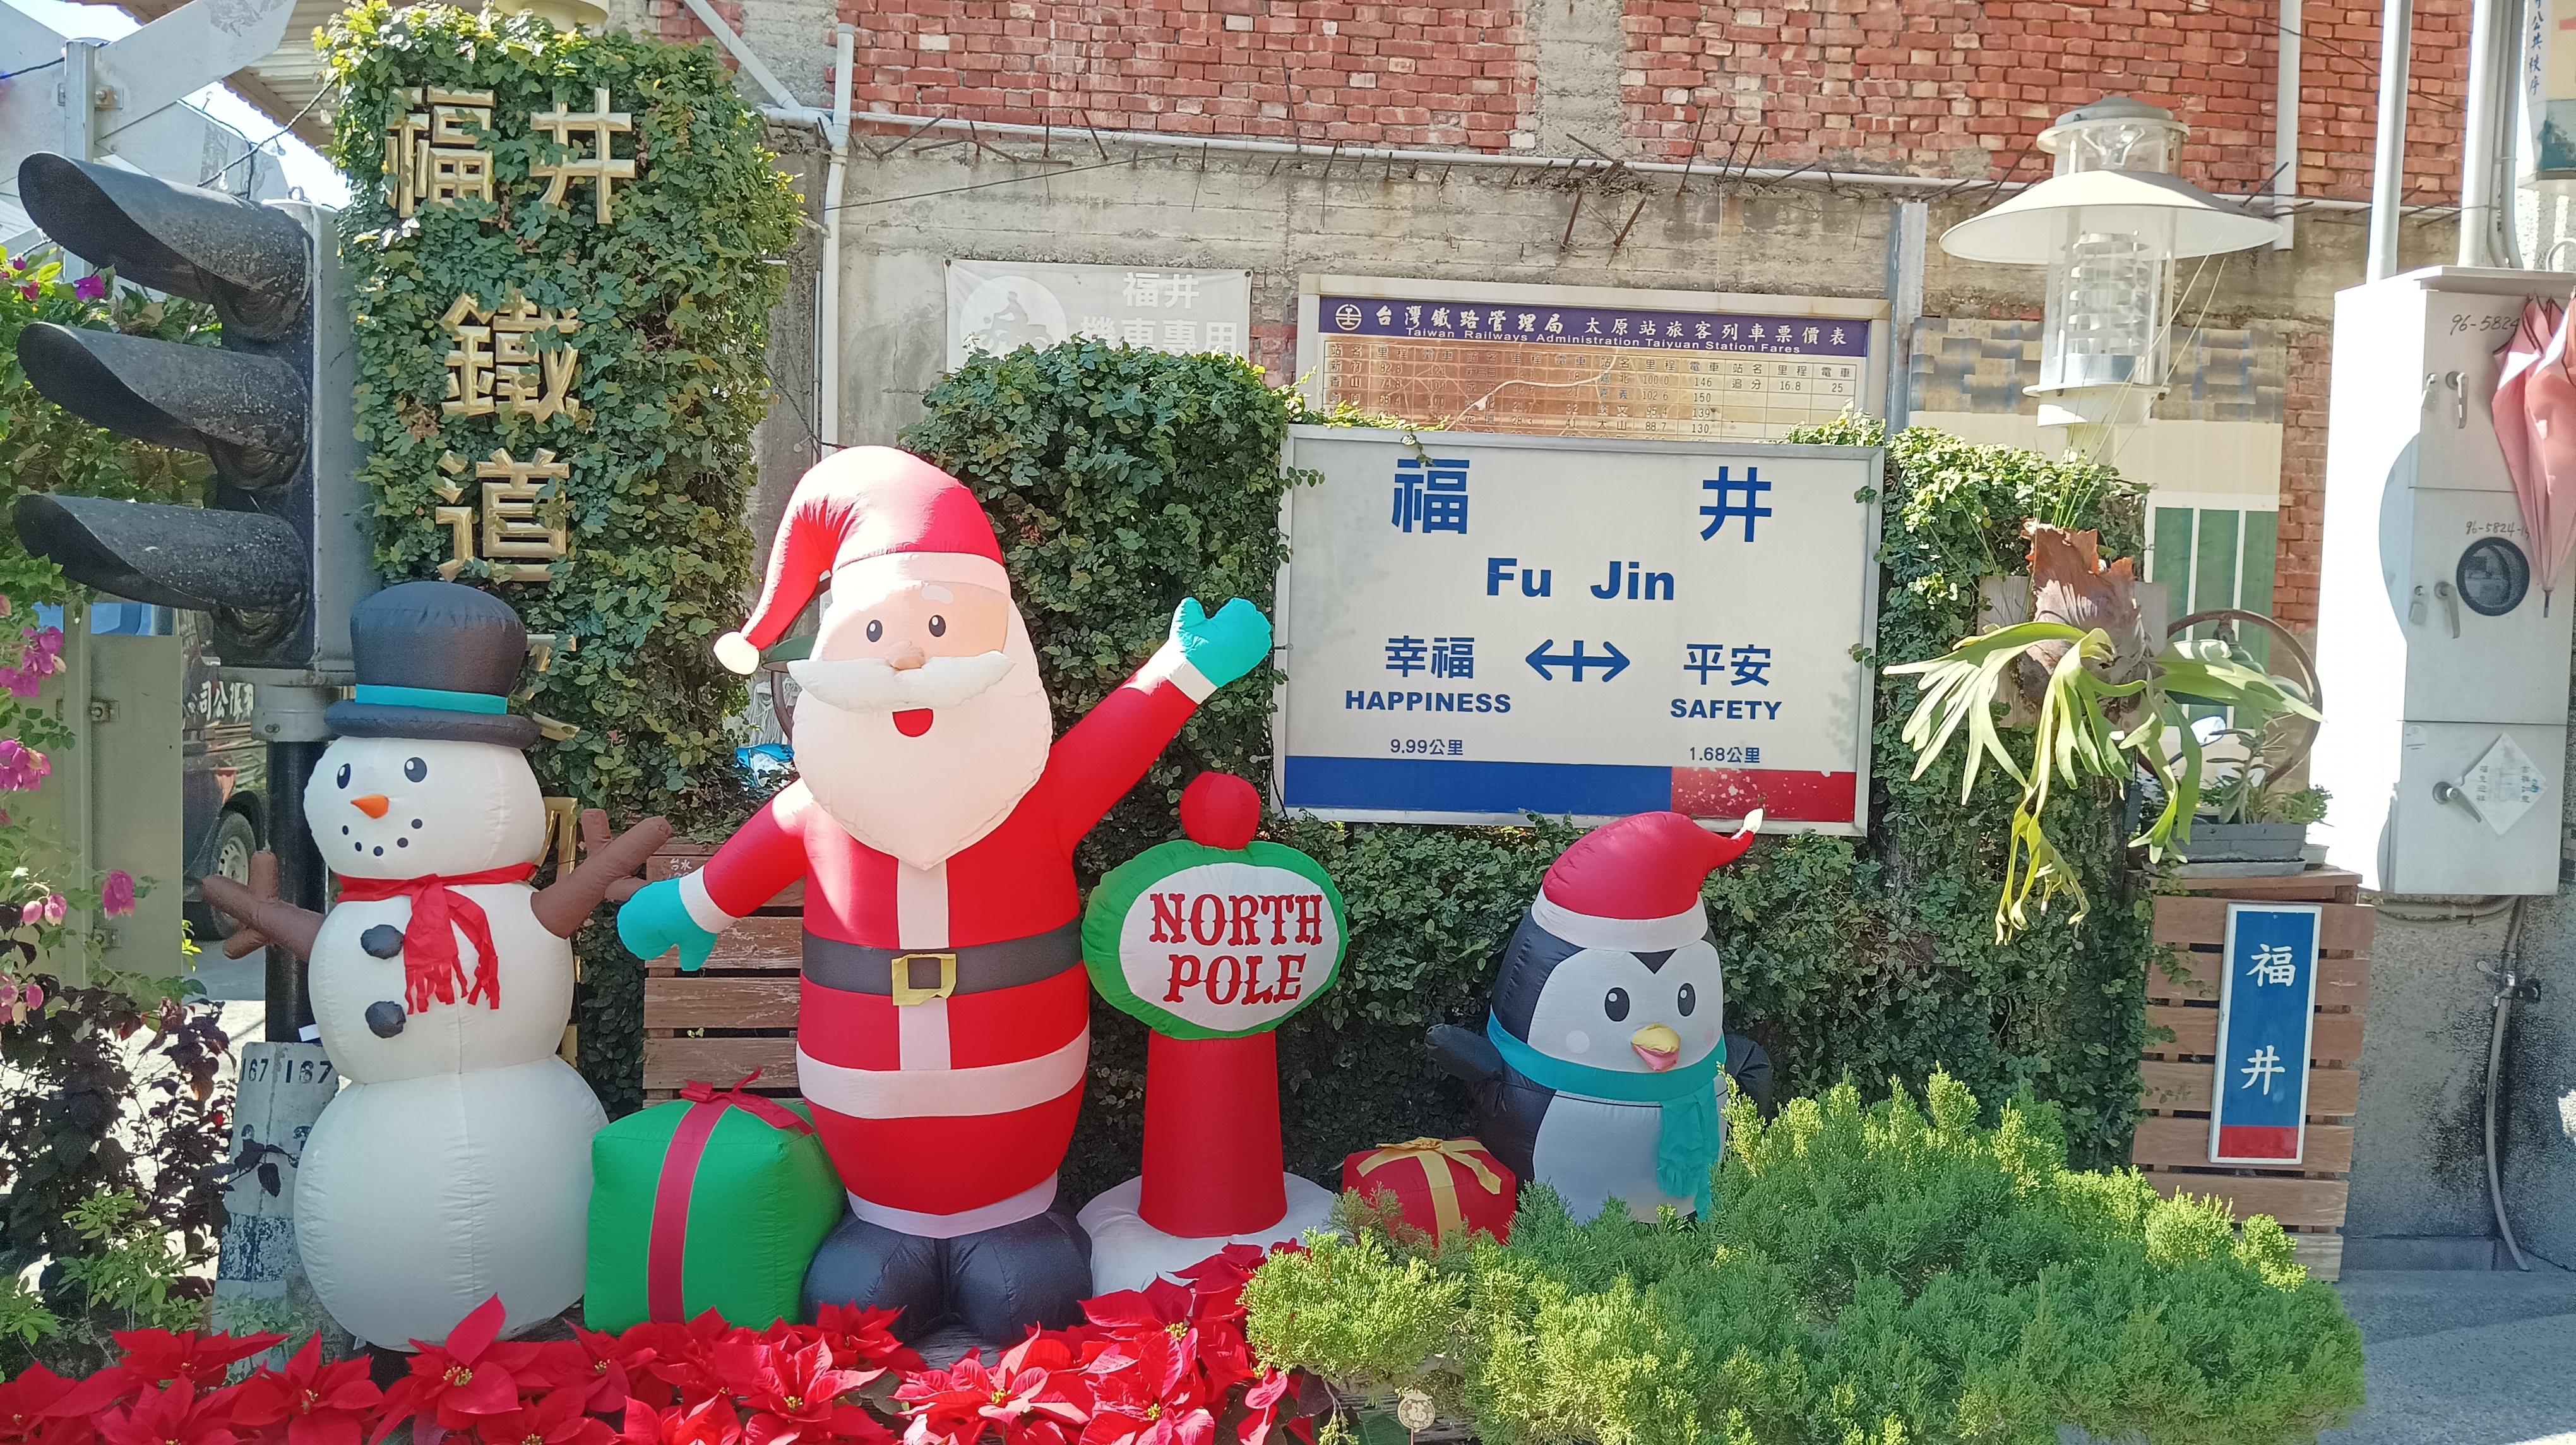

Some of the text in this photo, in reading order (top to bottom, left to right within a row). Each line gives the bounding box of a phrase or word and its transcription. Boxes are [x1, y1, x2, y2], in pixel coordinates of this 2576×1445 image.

[384, 85, 635, 225] 福井
[1122, 272, 1199, 309] 福井
[1376, 305, 1847, 346] 台灣鐵路管理局 太原站旅客列車票價表
[1405, 327, 1800, 354] Taiwan Railways Administration Taiyuan Station Fares
[1331, 345, 1850, 378] 站名 里程 電車 站名 里程 電車 站名 里程 電車 站名 里程 電車
[1330, 376, 1361, 387] 香山
[1693, 393, 1711, 402] 150
[1694, 377, 1712, 387] 146
[1732, 379, 1761, 390] 追分
[1780, 381, 1801, 391] 16.8
[1832, 383, 1843, 392] 25
[1597, 419, 1627, 431] 大山
[1691, 424, 1709, 433] 130
[1693, 408, 1710, 417] 139
[1486, 557, 1675, 601] Fu Jin
[1385, 635, 1475, 680] 幸福
[1683, 643, 1772, 687] 平安
[1345, 690, 1512, 714] HAPPINESS
[1670, 698, 1782, 721] SAFETY
[1390, 738, 1464, 757] 9.99公里
[1689, 746, 1761, 764] 1.68公里
[670, 858, 692, 871] 台水
[1149, 892, 1323, 946] NORTH
[1163, 953, 1307, 1005] POLE
[2241, 944, 2296, 1096] 福井
[241, 1058, 333, 1084] 167 167
